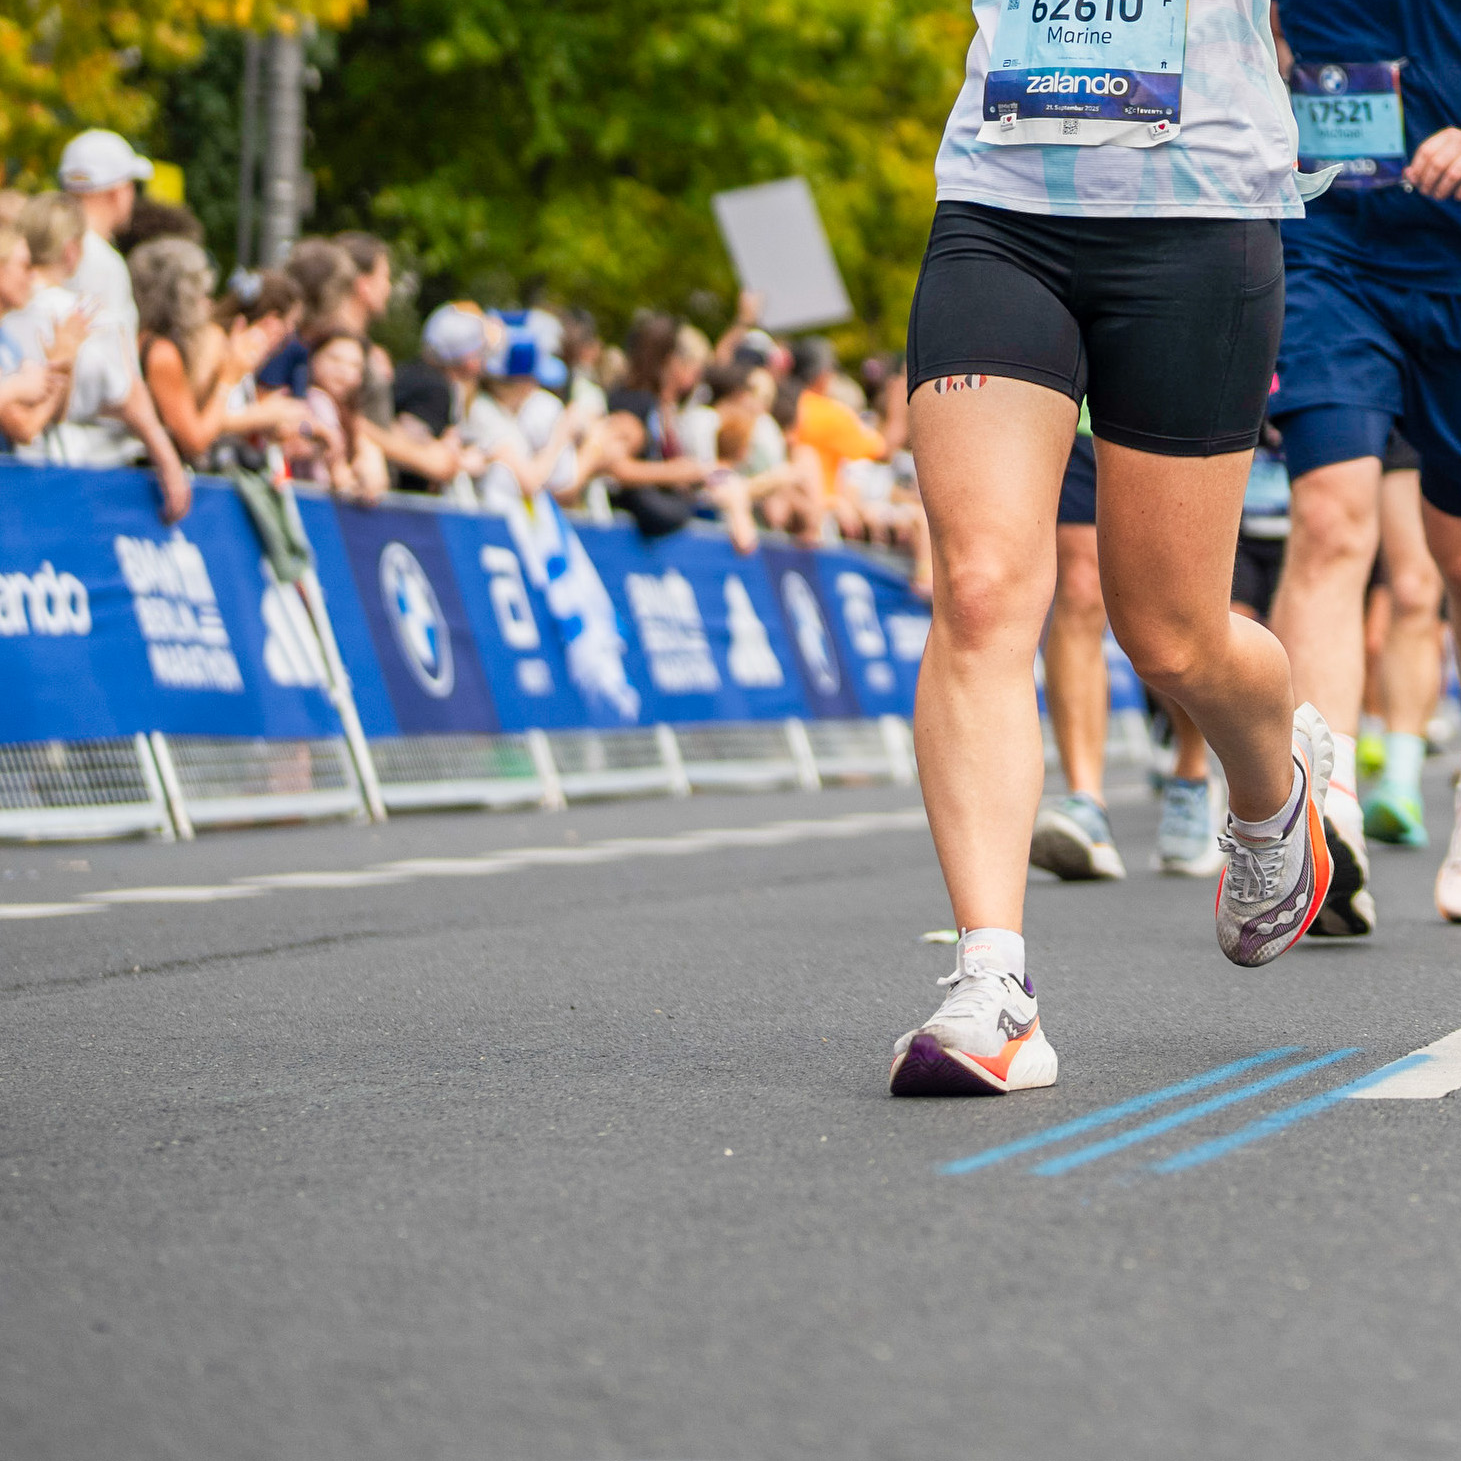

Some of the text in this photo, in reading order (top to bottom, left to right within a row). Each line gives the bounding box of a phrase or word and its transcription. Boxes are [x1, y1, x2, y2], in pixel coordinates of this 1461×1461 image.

[1047, 26, 1112, 45] Marine
[1026, 71, 1129, 96] zalando
[1054, 103, 1084, 112] September
